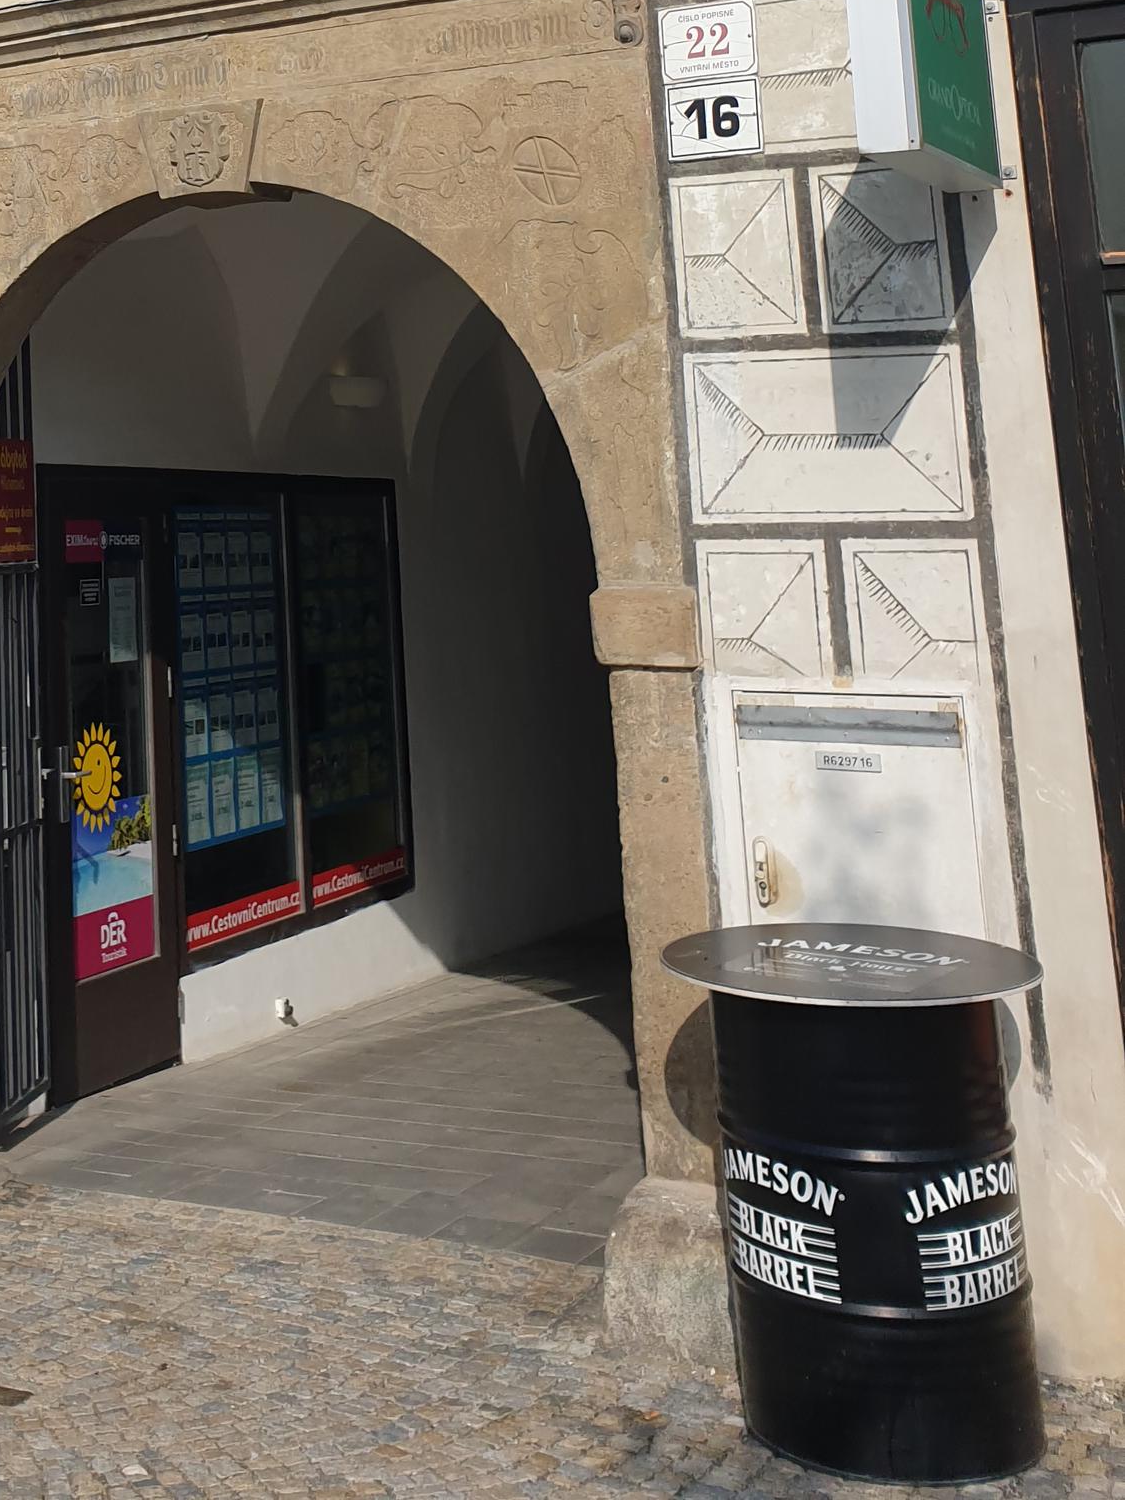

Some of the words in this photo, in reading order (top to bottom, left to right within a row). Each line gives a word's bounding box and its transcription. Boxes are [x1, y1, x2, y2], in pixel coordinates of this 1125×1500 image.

[678, 12, 700, 23] ČÍSLO
[701, 8, 734, 20] POPISNÉ
[686, 22, 730, 59] 22
[713, 59, 740, 71] MĚSTO
[684, 95, 741, 140] 16
[758, 938, 965, 966] JAMESON
[724, 1148, 840, 1217] JAMESON
[905, 1162, 1017, 1224] JAMESON
[739, 1200, 808, 1255] BLACK
[947, 1216, 1013, 1266] BLACK
[738, 1237, 824, 1300] BARREL
[944, 1256, 1021, 1308] BARREL
